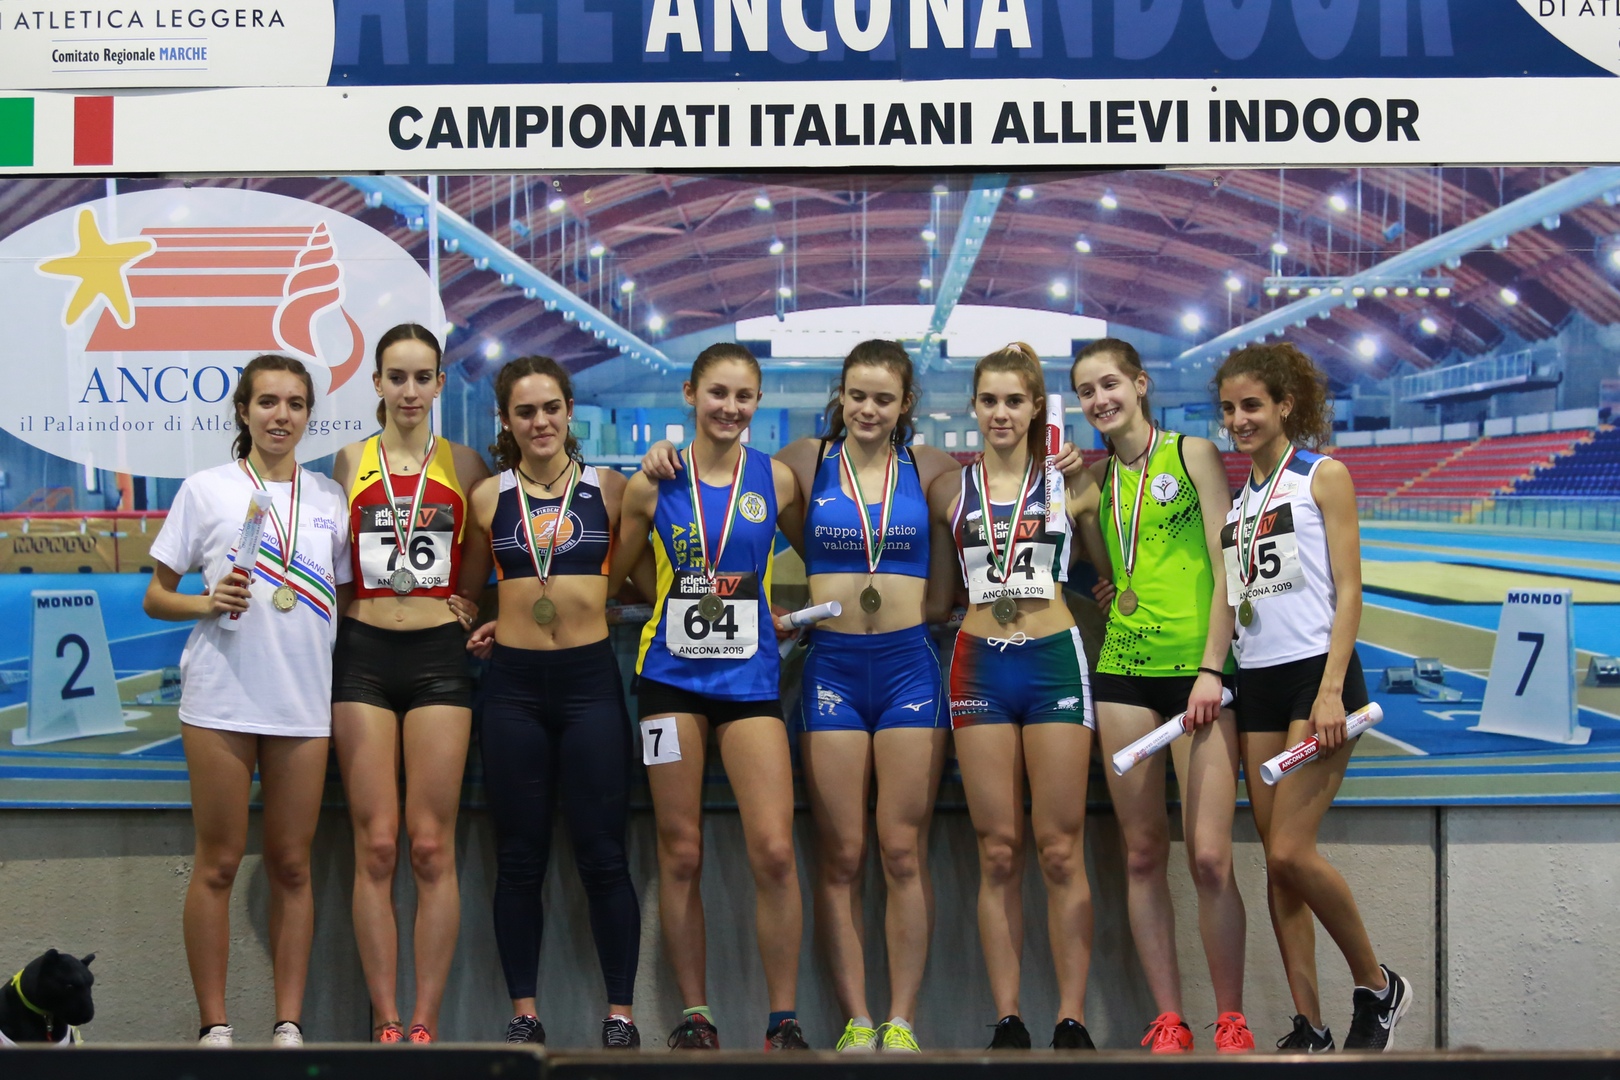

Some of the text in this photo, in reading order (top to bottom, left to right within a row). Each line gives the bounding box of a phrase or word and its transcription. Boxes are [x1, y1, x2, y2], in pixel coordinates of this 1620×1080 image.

[14, 10, 144, 30] ATLETICA
[156, 9, 285, 29] LEGGERA
[52, 46, 208, 66] Comitato Regionale MARCHE
[388, 97, 1420, 150] CAMPIONATI ITALIANI ALLIEVI INDOOR
[78, 365, 245, 404] ANCO
[19, 415, 363, 436] il Palaindoor di Atle ggera
[375, 507, 411, 518] atleica
[814, 524, 858, 539] gruppo
[380, 535, 436, 572] 76
[986, 546, 1036, 584] 84
[717, 577, 739, 594] TV
[982, 586, 1044, 600] ANCONA 2019
[1271, 581, 1293, 594] 2019
[36, 595, 95, 609] MONDO
[1507, 592, 1563, 606] MONDO
[683, 603, 739, 641] 64
[678, 646, 745, 655] ANCONA 2019
[55, 633, 96, 701] 2
[1514, 631, 1546, 697] 7
[648, 727, 664, 758] 7
